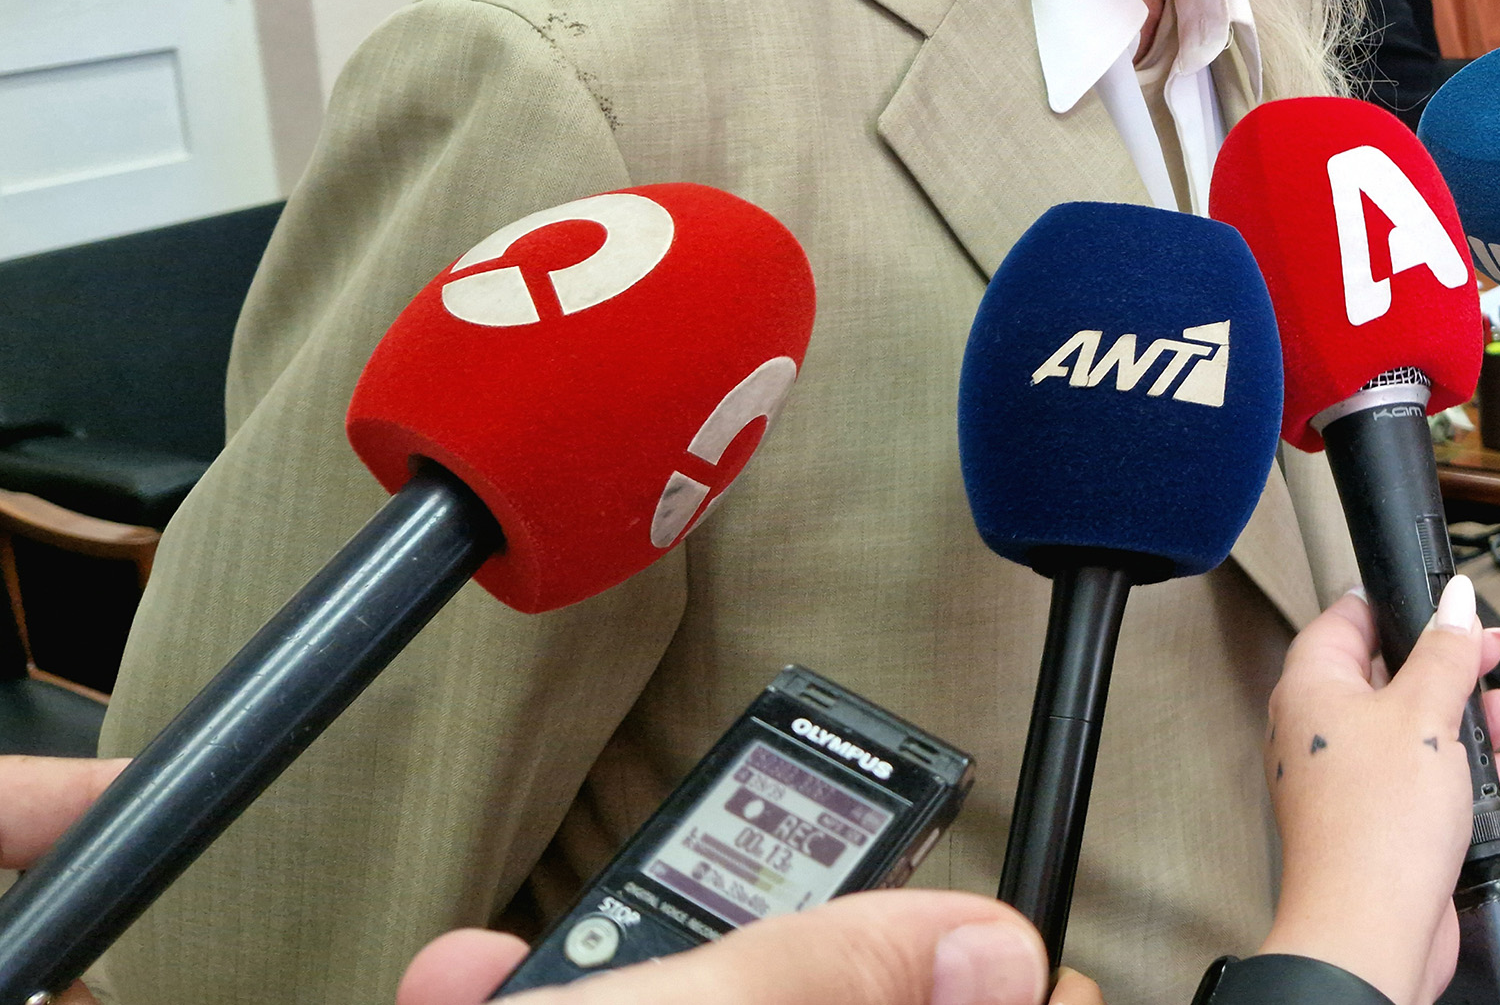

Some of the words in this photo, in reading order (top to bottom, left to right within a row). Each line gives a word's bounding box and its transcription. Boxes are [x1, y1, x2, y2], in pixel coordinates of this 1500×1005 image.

[791, 718, 894, 780] OLYMPUS
[773, 815, 825, 856] REC
[597, 896, 641, 926] STOP
